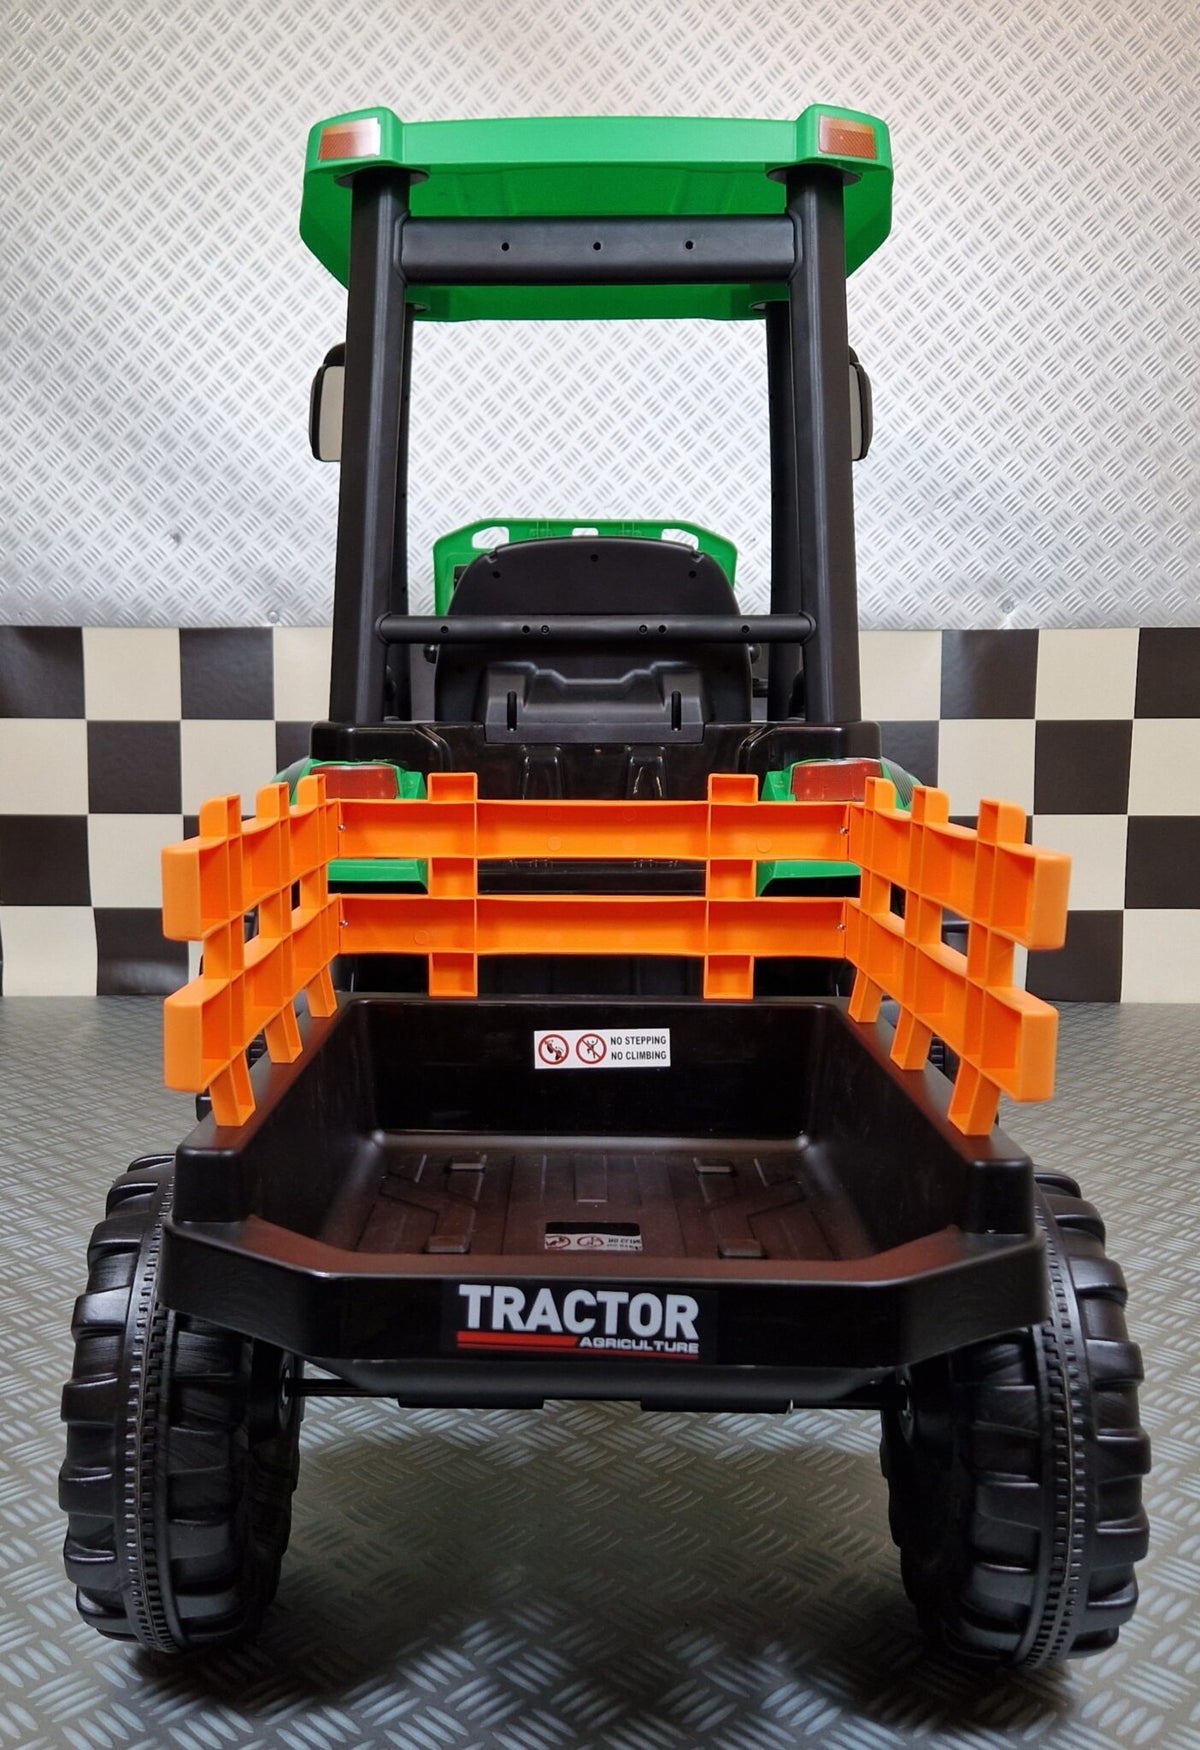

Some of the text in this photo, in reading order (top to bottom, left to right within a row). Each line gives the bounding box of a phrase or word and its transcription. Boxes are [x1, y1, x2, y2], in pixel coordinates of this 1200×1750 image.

[610, 1035, 667, 1046] NO STEPPING
[611, 1050, 667, 1061] NO CLIMBING
[458, 1284, 699, 1340] TRACTOR
[579, 1336, 700, 1354] AGRICULTURE
